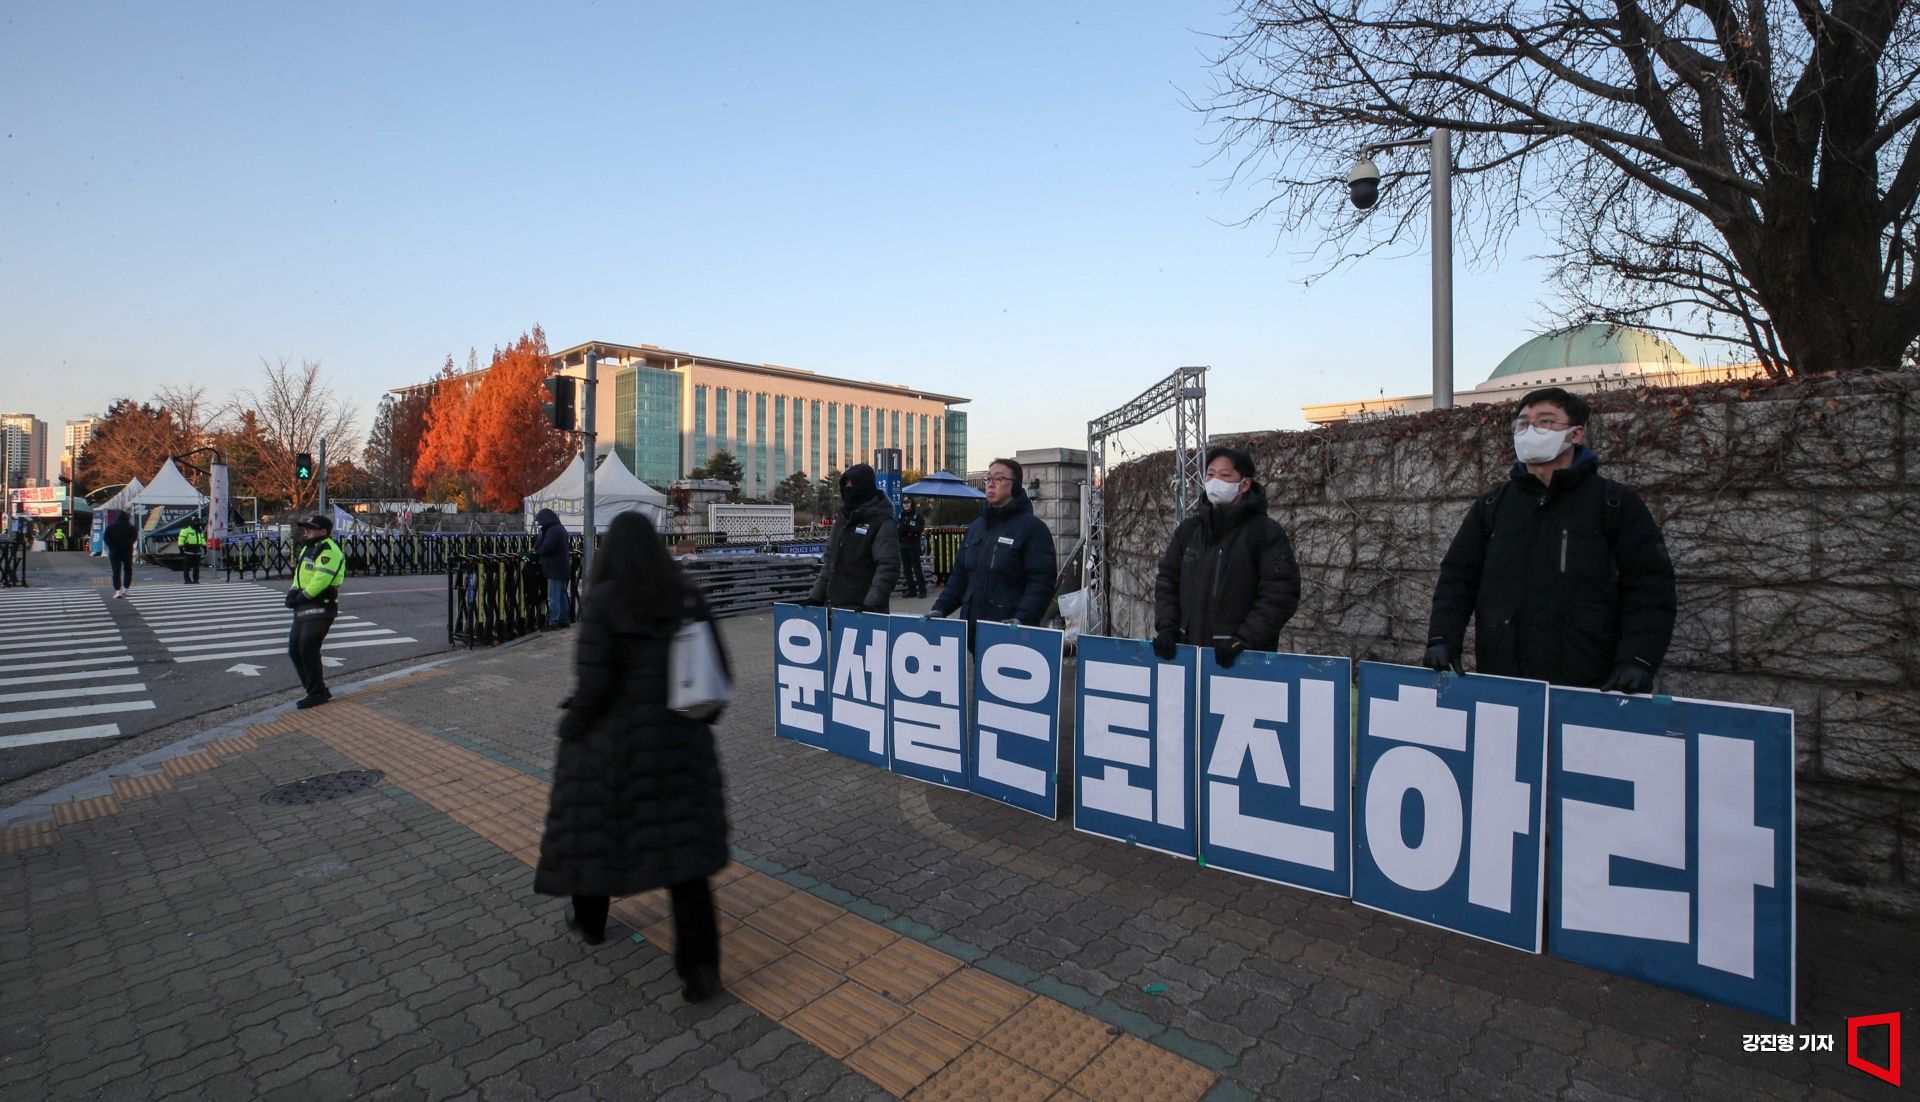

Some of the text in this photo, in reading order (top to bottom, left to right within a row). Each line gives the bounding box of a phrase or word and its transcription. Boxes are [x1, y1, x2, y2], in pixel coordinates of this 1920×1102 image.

[877, 453, 882, 470] 1
[892, 453, 898, 470] 1
[778, 618, 1775, 979] 윤석열은 퇴진하라
